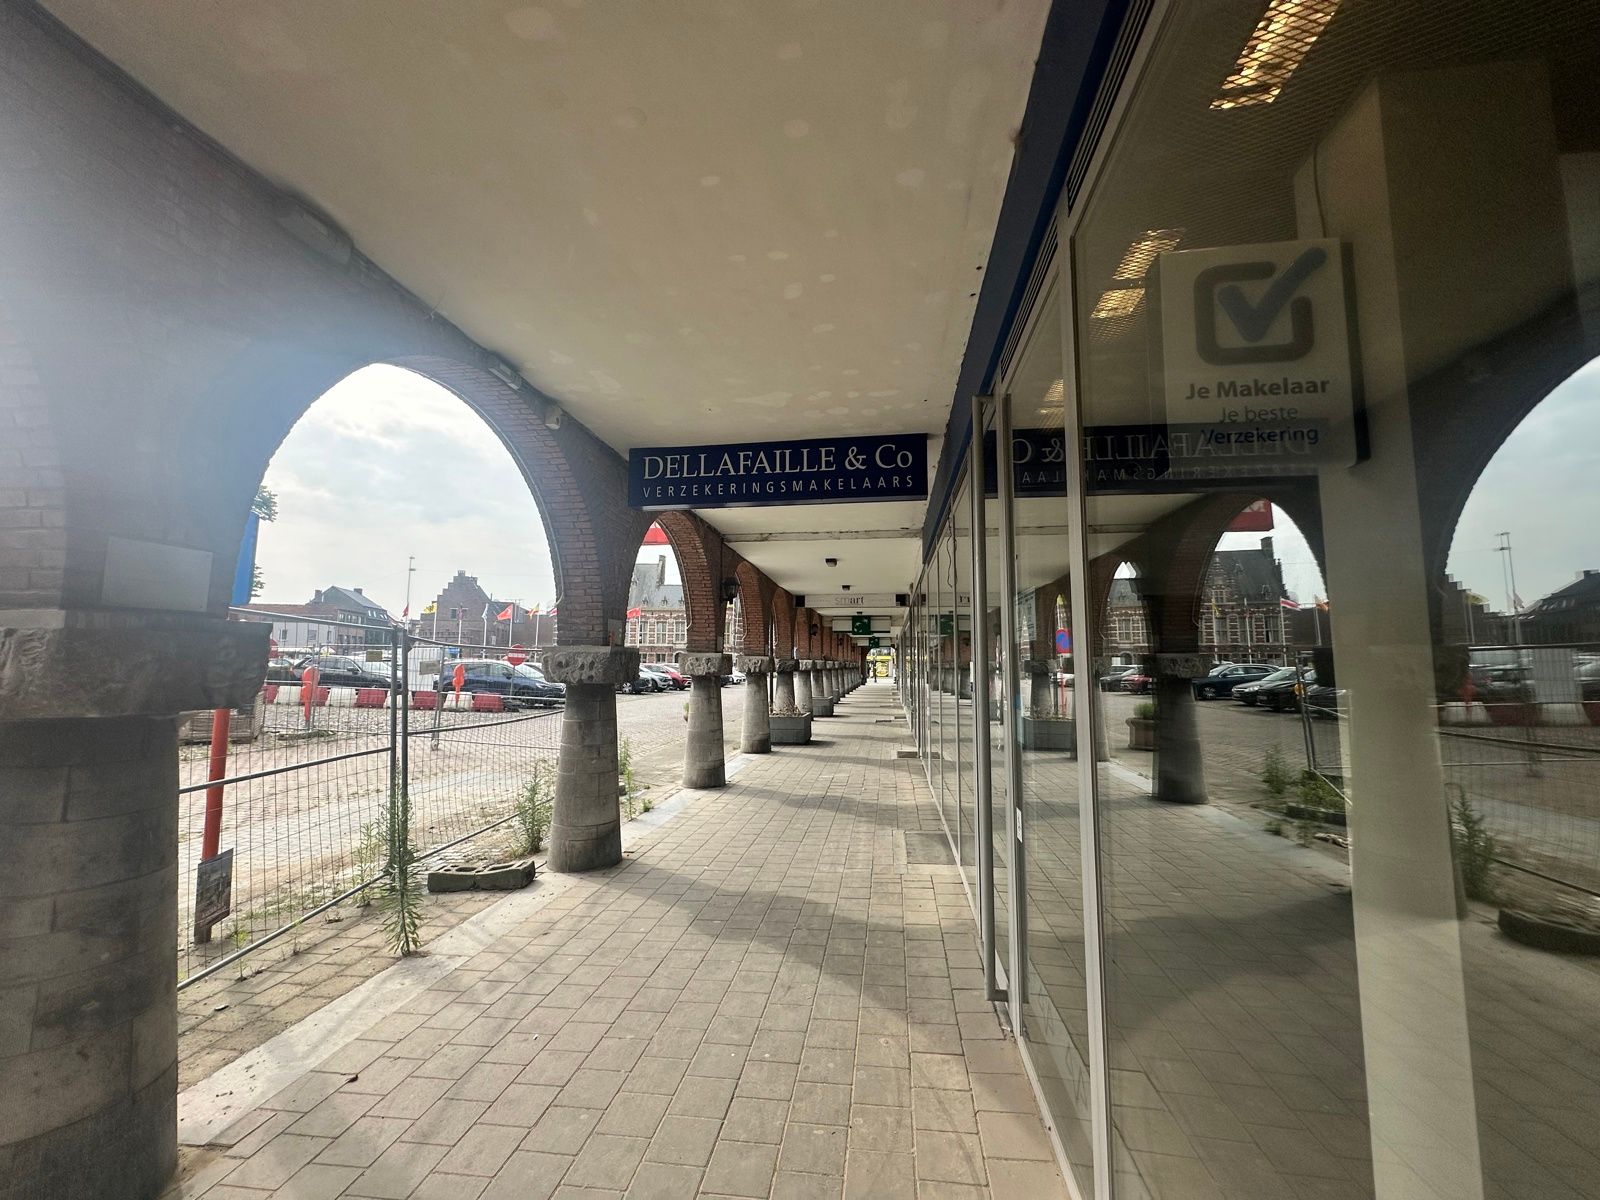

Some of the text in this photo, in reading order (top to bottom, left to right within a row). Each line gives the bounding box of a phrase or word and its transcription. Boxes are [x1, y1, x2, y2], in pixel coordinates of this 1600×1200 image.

[1185, 376, 1330, 401] Je Makelaar
[1219, 405, 1298, 424] Je beste
[1201, 426, 1319, 445] Verzekering
[643, 444, 913, 480] DELLAFAILLE & Co
[643, 474, 913, 499] VERZEKERINGSMAKELAARS
